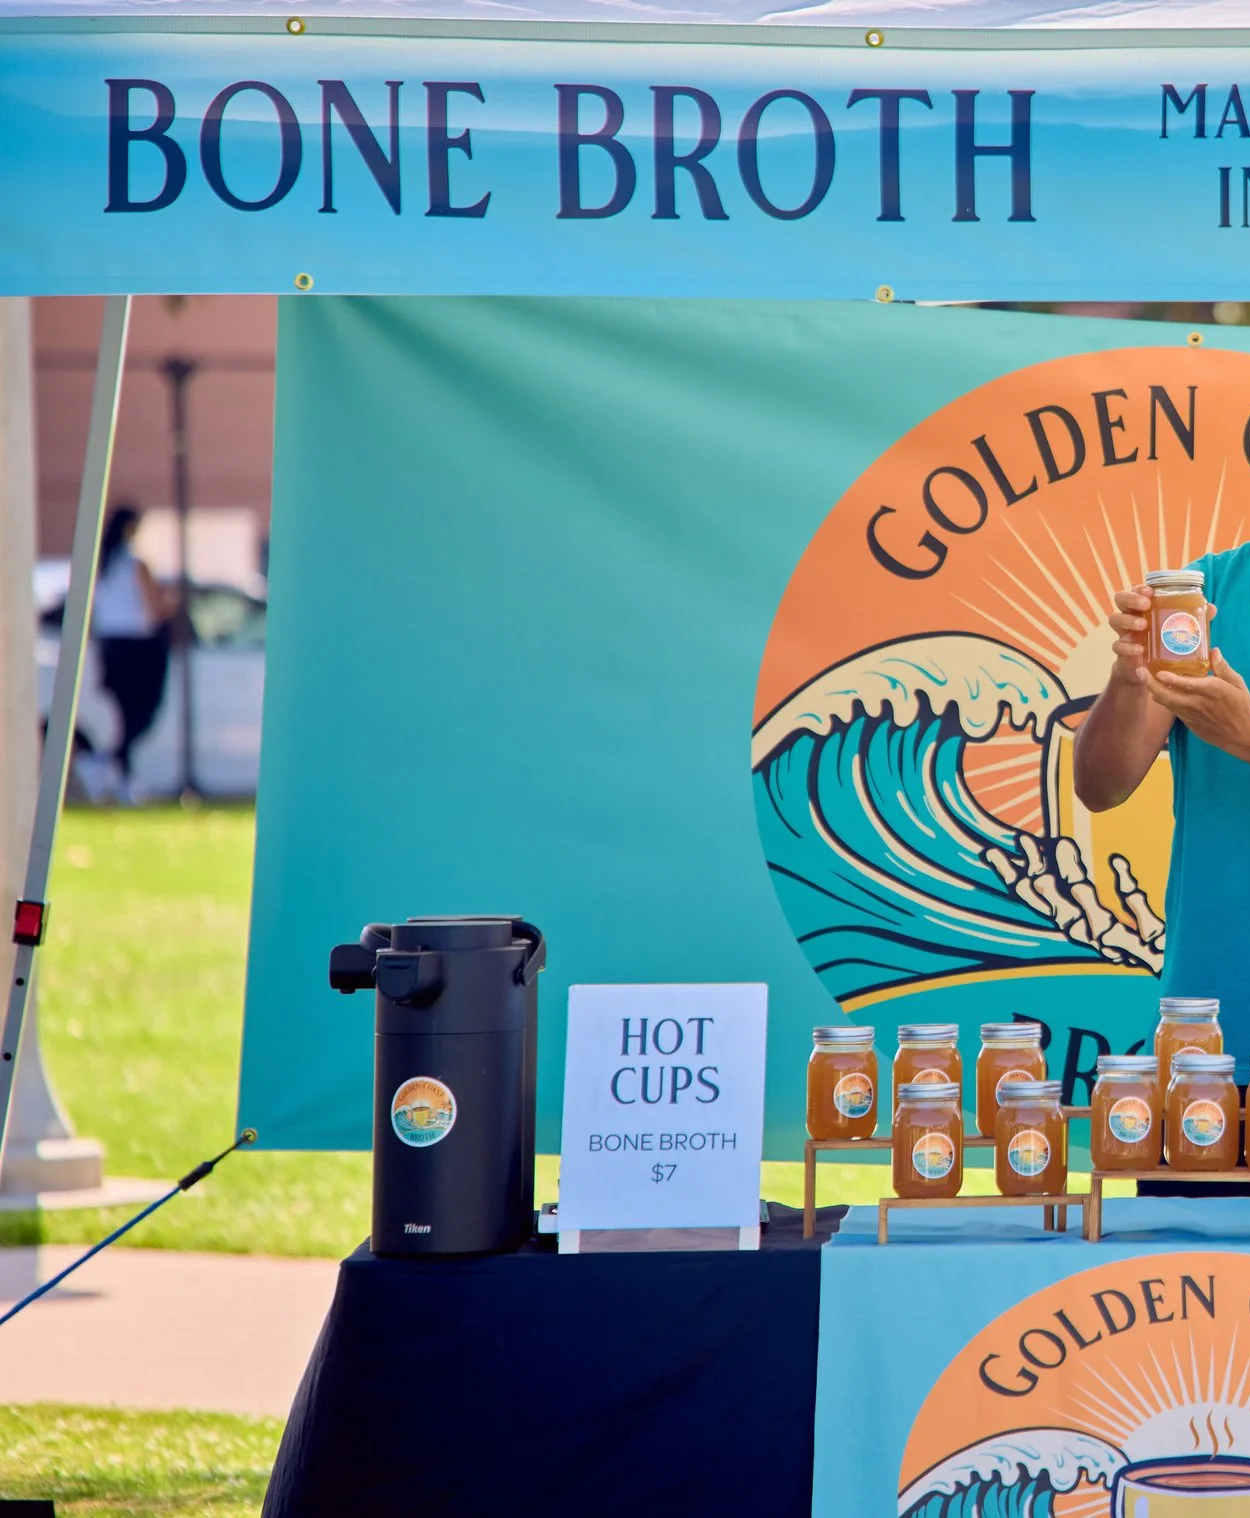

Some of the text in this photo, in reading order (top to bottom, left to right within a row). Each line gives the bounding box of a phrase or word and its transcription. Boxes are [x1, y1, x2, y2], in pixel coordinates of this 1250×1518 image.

[103, 78, 1037, 223] BONE BROTH
[865, 384, 1200, 581] GOLDEN
[619, 1017, 715, 1056] HOT
[611, 1065, 721, 1105] CUPS
[588, 1132, 737, 1152] BONE BROTH
[650, 1162, 678, 1184] $7
[403, 1222, 432, 1234] Tiken
[977, 1274, 1217, 1399] GOLDEN
